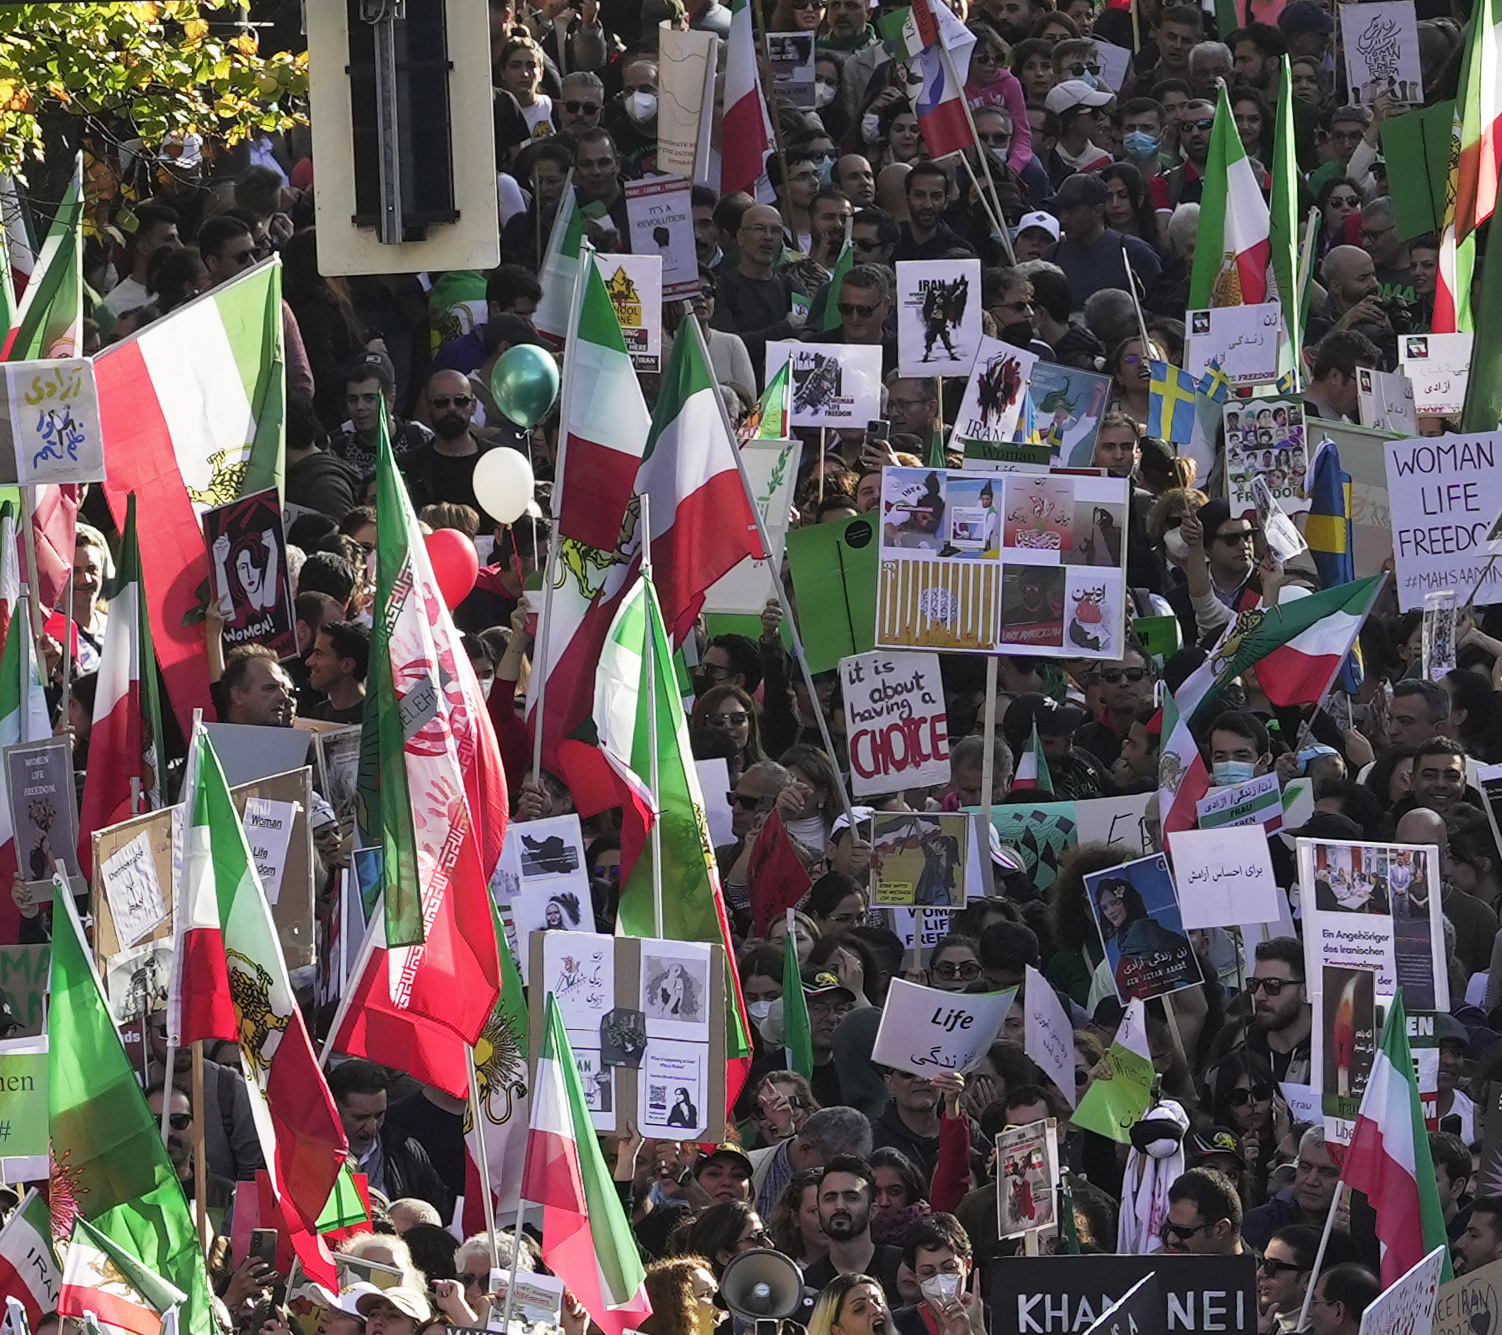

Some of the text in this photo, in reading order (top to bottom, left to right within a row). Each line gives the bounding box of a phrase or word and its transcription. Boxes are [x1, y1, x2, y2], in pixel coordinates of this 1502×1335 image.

[847, 659, 895, 685] it is
[869, 670, 925, 705] about
[851, 690, 937, 725] having a
[849, 712, 950, 780] CHOICE
